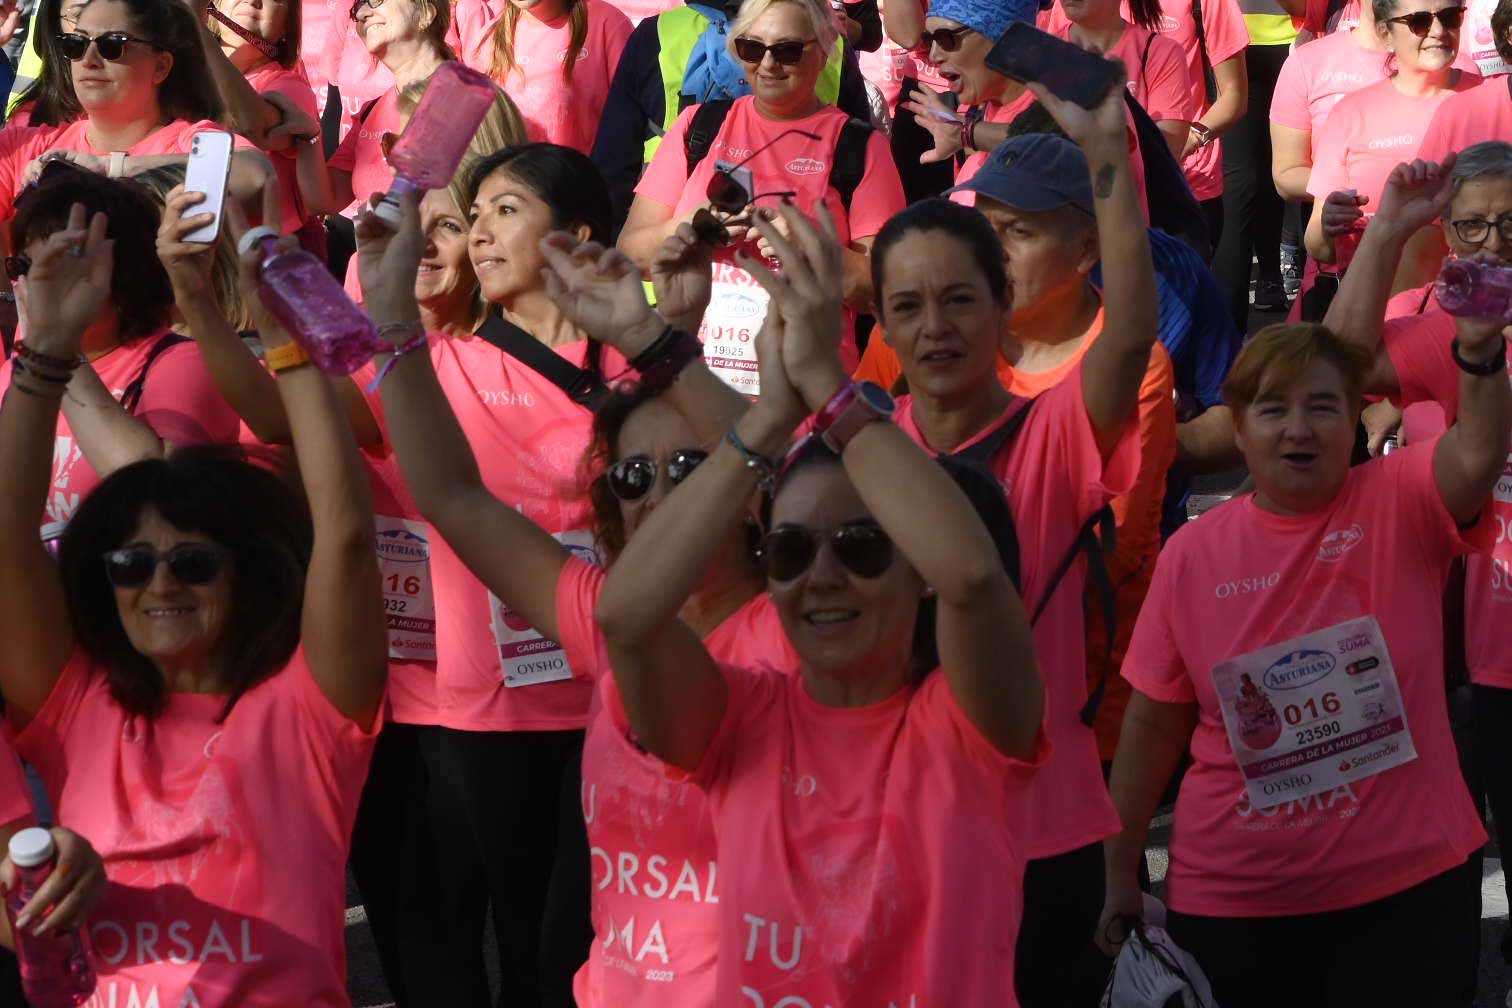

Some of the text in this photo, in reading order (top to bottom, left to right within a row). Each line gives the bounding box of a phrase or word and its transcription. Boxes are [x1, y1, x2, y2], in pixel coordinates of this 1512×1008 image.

[713, 345, 744, 357] 19025
[1215, 572, 1281, 599] OYSHO
[517, 657, 564, 675] OYSHO
[1269, 660, 1331, 688] ASTURIANA
[1283, 691, 1341, 726] 016
[1295, 720, 1341, 745] 23590
[1260, 751, 1304, 772] CARRERA
[1305, 748, 1320, 759] DE
[1320, 744, 1334, 754] LA
[1351, 742, 1400, 769] Santander
[1263, 773, 1312, 796] OYSHO
[743, 912, 802, 971] TU
